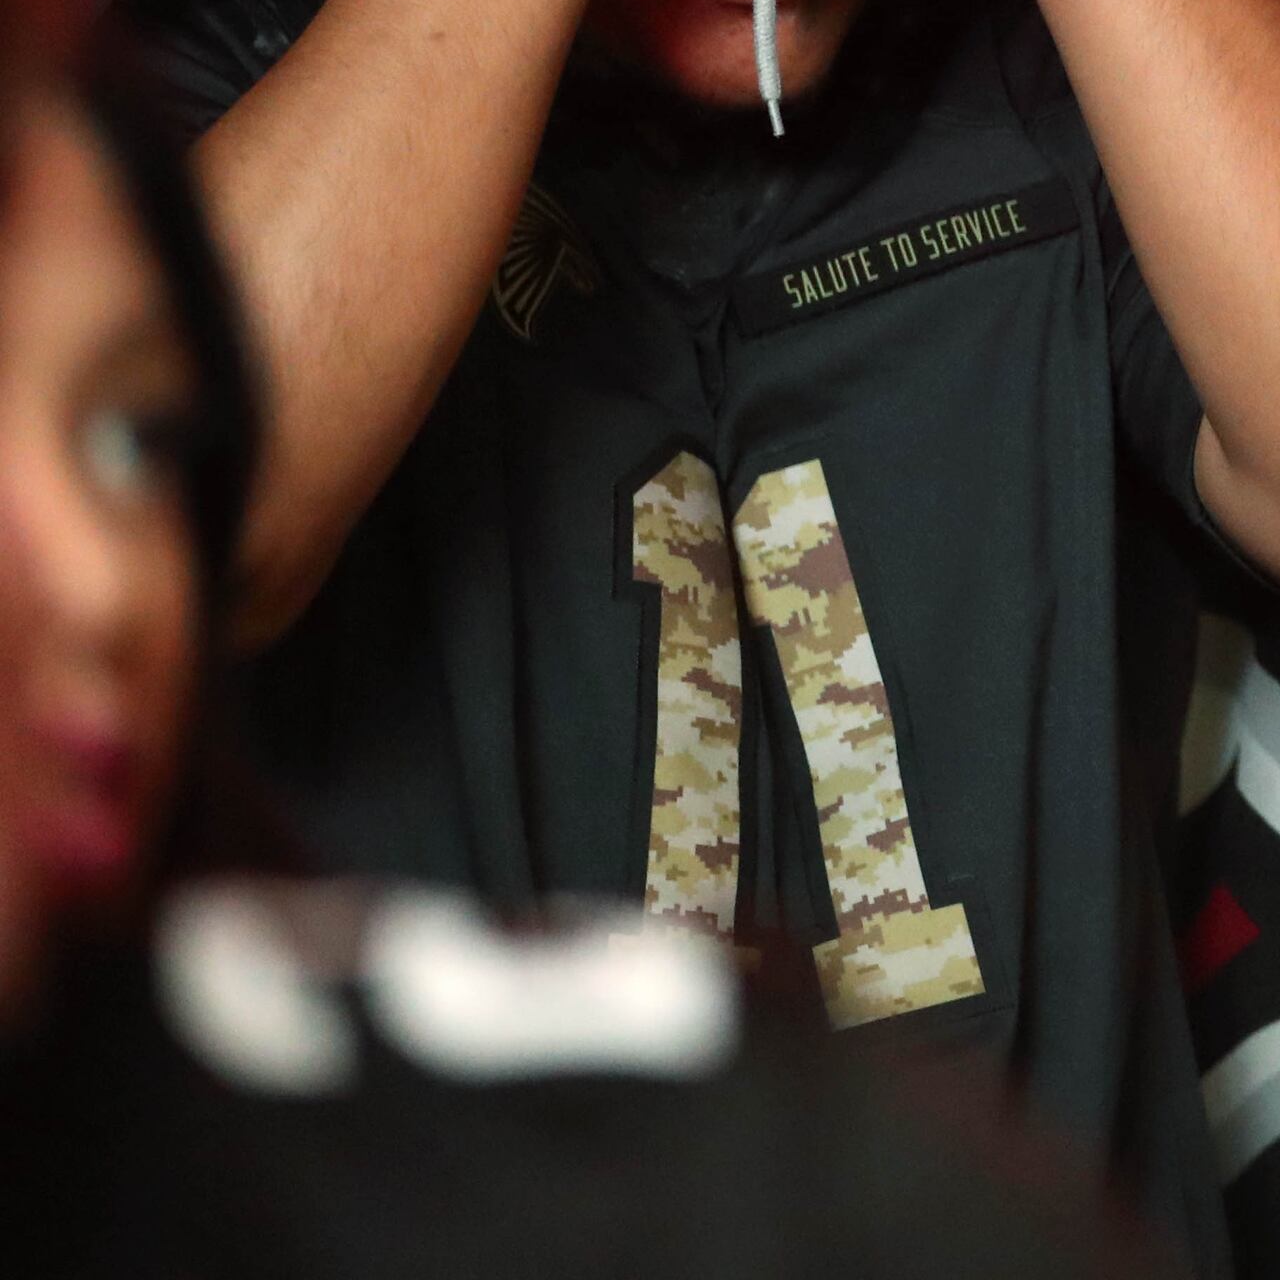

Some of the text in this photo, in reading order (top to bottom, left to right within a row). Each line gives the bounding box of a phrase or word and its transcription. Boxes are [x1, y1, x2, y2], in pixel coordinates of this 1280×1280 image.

[783, 200, 1027, 308] SALUTE TO SERVICE
[610, 450, 987, 1032] 11
